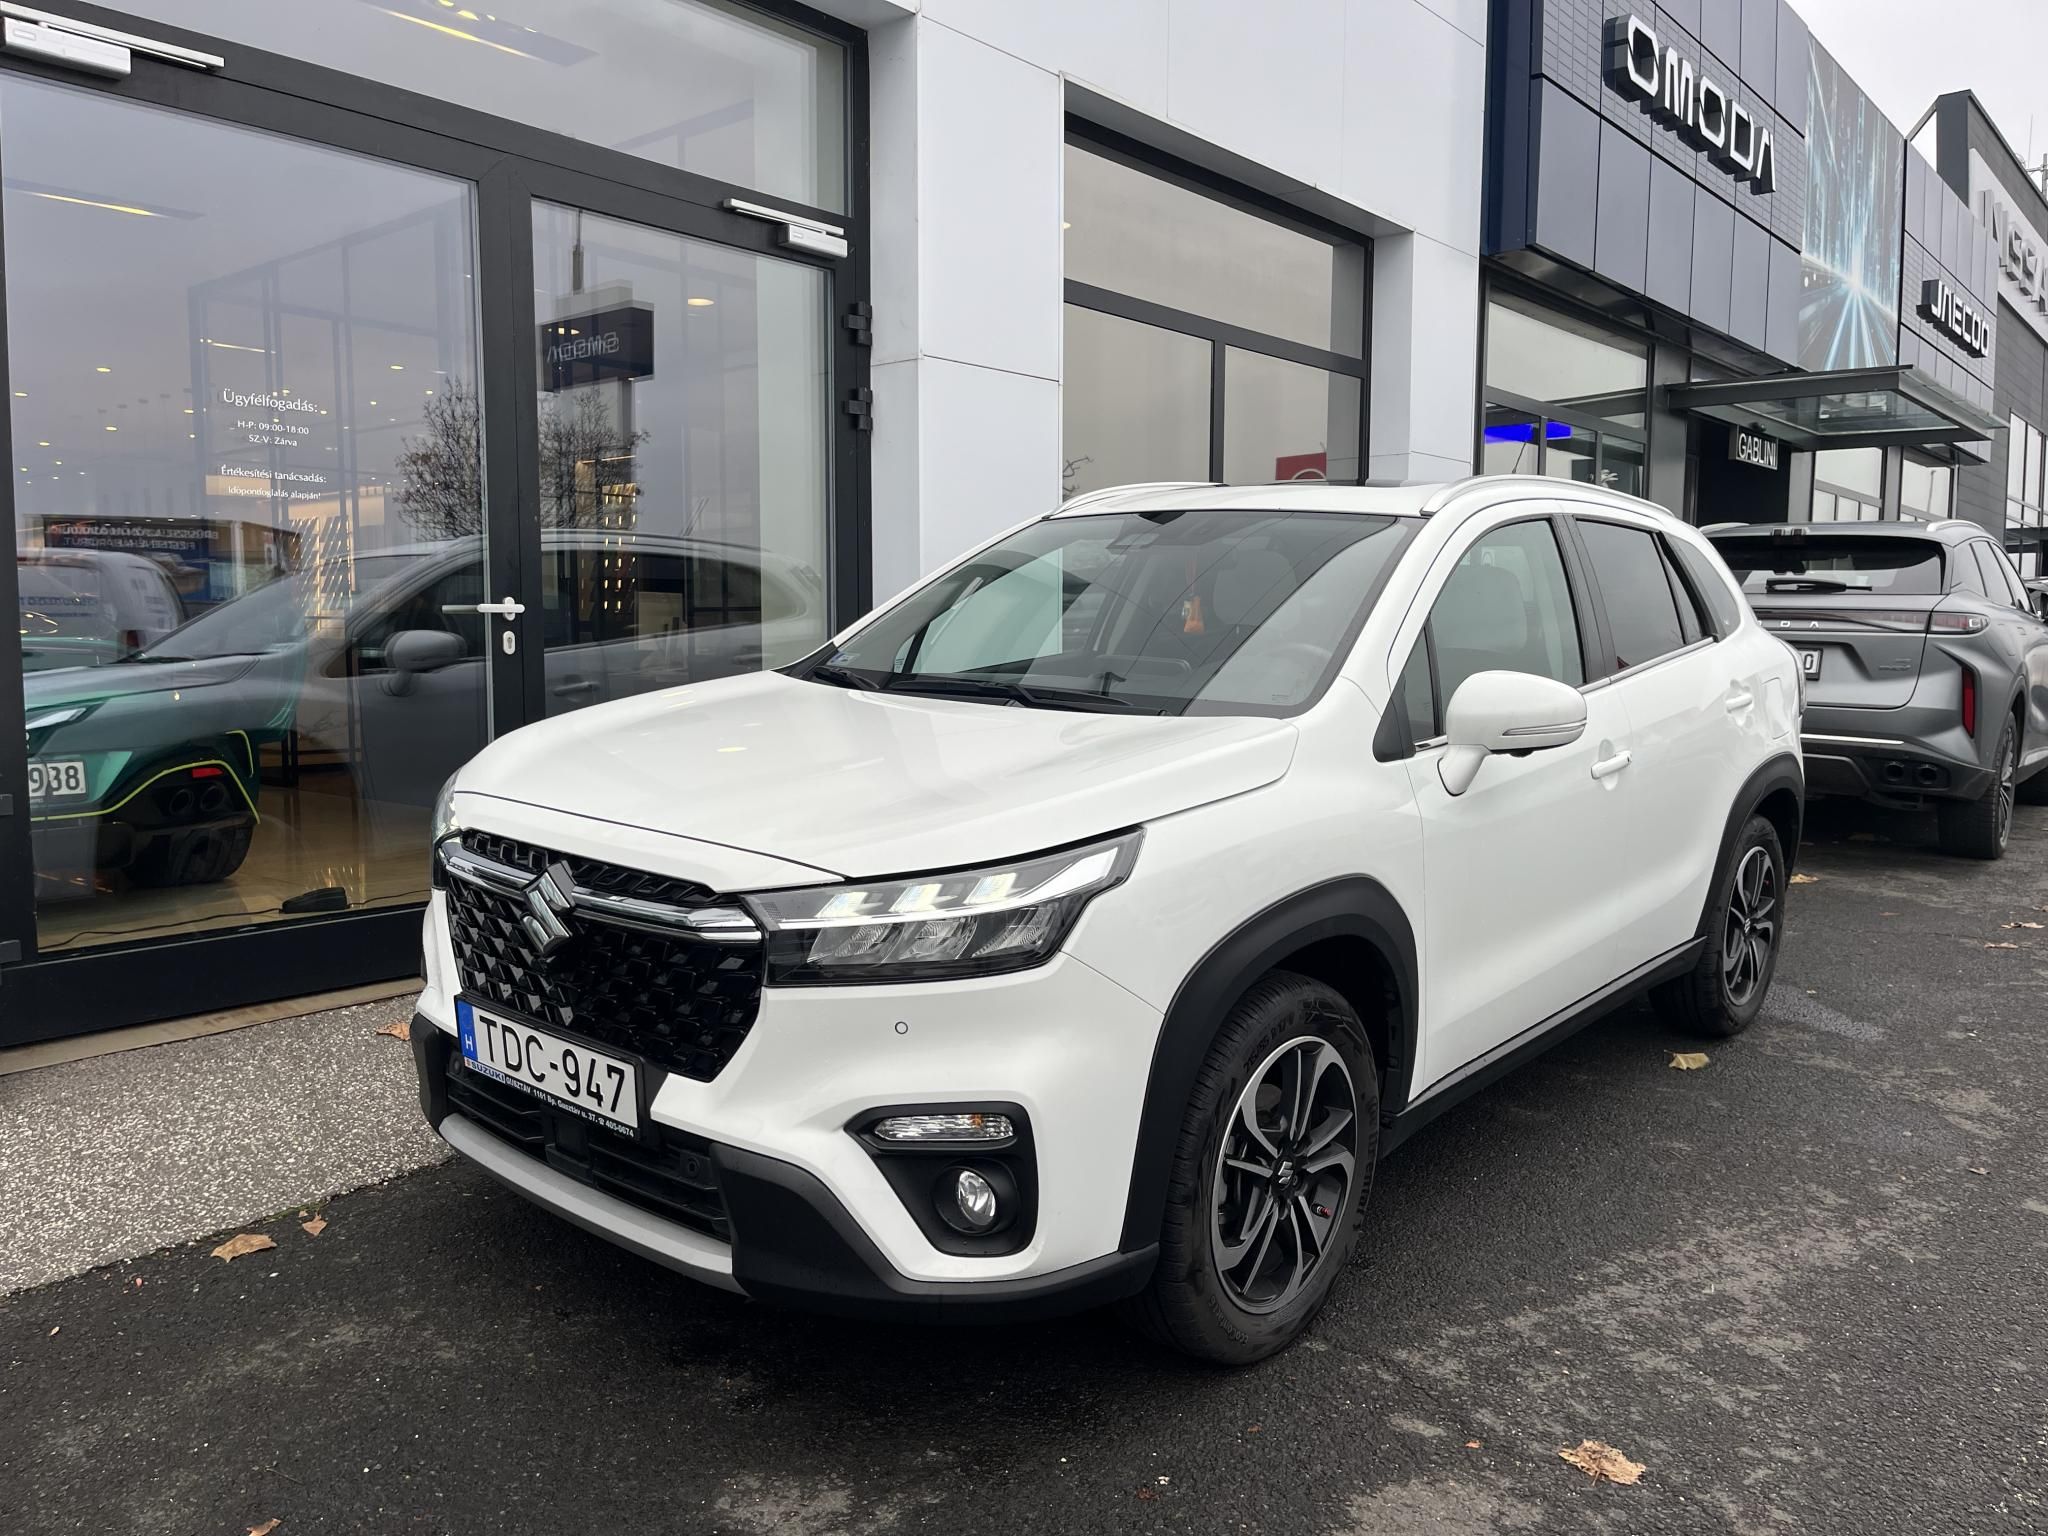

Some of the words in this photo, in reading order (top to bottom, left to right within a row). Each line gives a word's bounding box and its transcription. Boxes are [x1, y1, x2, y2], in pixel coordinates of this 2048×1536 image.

[1626, 14, 1776, 193] OMODA
[1929, 279, 1990, 358] JAECOO
[223, 388, 318, 412] Ügyfélfogadás:
[237, 420, 257, 429] H-P:
[258, 422, 310, 435] 09:00-18:00
[248, 434, 272, 443] SZ-V:
[274, 436, 298, 447] Zárva
[1738, 433, 1777, 466] GABLINI
[221, 464, 272, 479] Értékesítési
[274, 471, 327, 483] tanácsadás:
[290, 490, 321, 501] alapján!
[464, 1033, 474, 1052] H
[471, 1061, 506, 1084] SUZUKI
[478, 1014, 626, 1114] TDC-947
